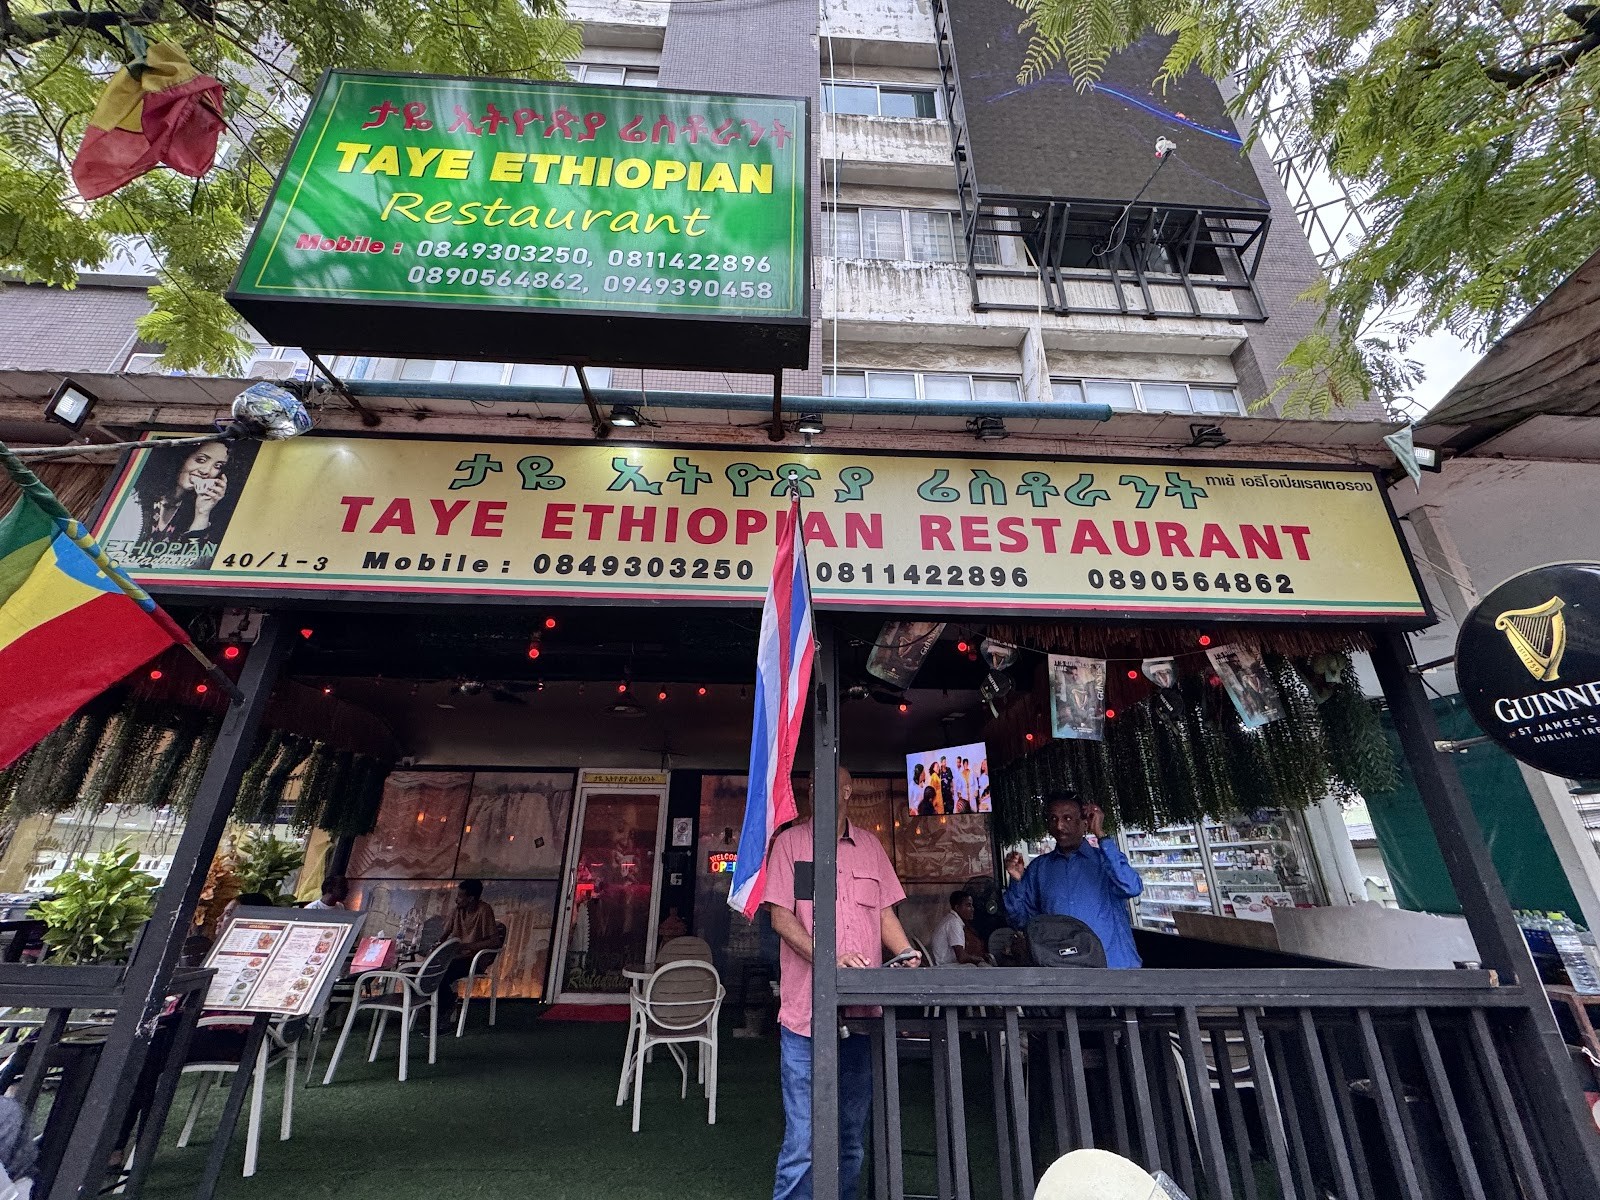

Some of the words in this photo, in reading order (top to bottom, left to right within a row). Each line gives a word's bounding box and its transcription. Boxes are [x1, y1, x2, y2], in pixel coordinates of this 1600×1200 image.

[335, 142, 475, 180] TAYE
[489, 152, 775, 194] ETHIOPIAN
[380, 192, 711, 237] Restaurant
[295, 233, 385, 255] Mobile
[416, 240, 594, 268] 0849303250,
[608, 249, 772, 273] 0811422896
[407, 265, 589, 294] 0890564862,
[603, 275, 773, 299] 0949390458
[340, 496, 508, 537] TAYE
[541, 502, 884, 549] ETHIOPIAN
[919, 514, 1311, 561] RESTAURANT
[105, 540, 218, 558] ETHIOPIAN
[222, 551, 328, 571] 40/1-3
[533, 553, 753, 580] 0849303250
[816, 561, 1028, 587] 0811422896
[1088, 568, 1294, 593] 0890564862
[1524, 657, 1539, 673] 1759
[1518, 726, 1532, 736] ST
[1538, 714, 1598, 732] JAMES'S
[709, 853, 738, 863] WELCO
